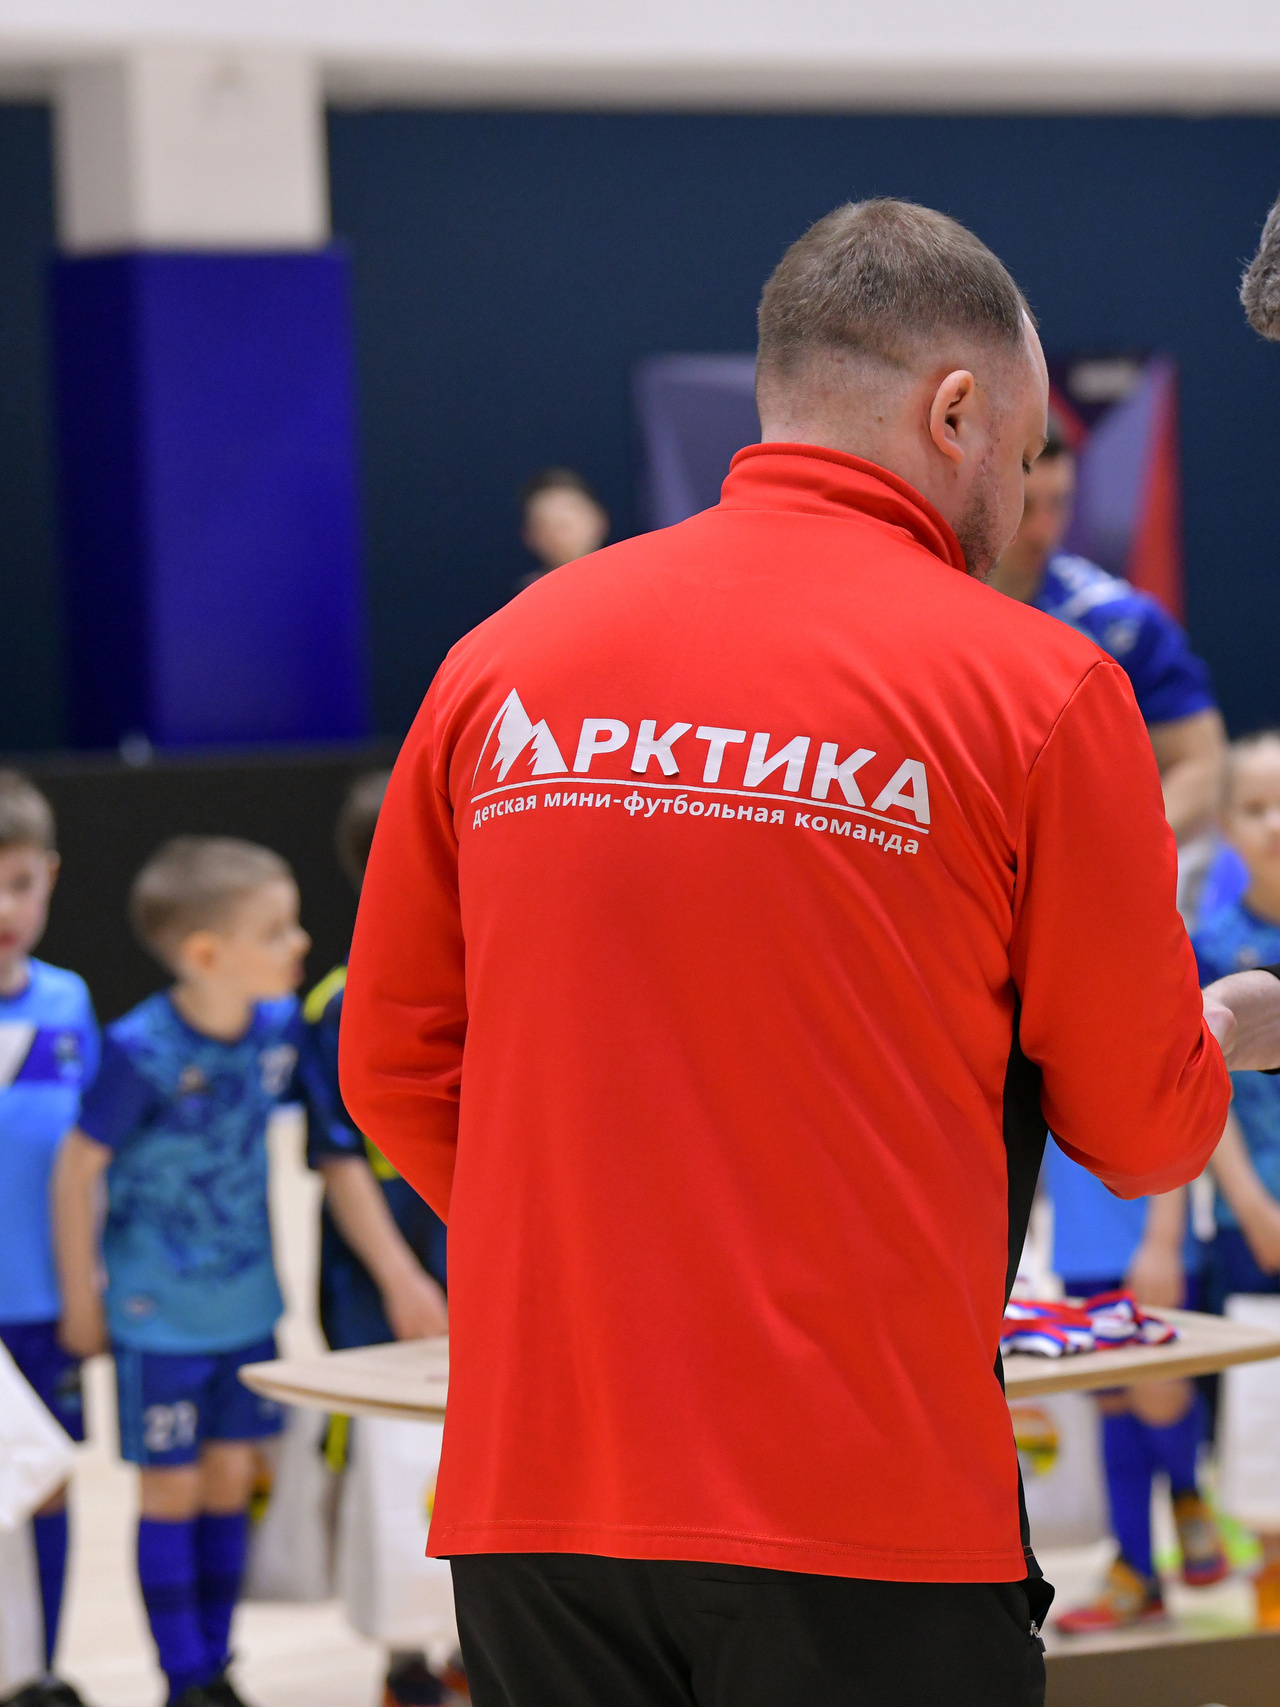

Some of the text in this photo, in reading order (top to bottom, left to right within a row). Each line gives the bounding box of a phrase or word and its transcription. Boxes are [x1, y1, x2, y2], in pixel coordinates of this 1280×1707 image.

[472, 790, 919, 855] детская мини-футбольная команда
